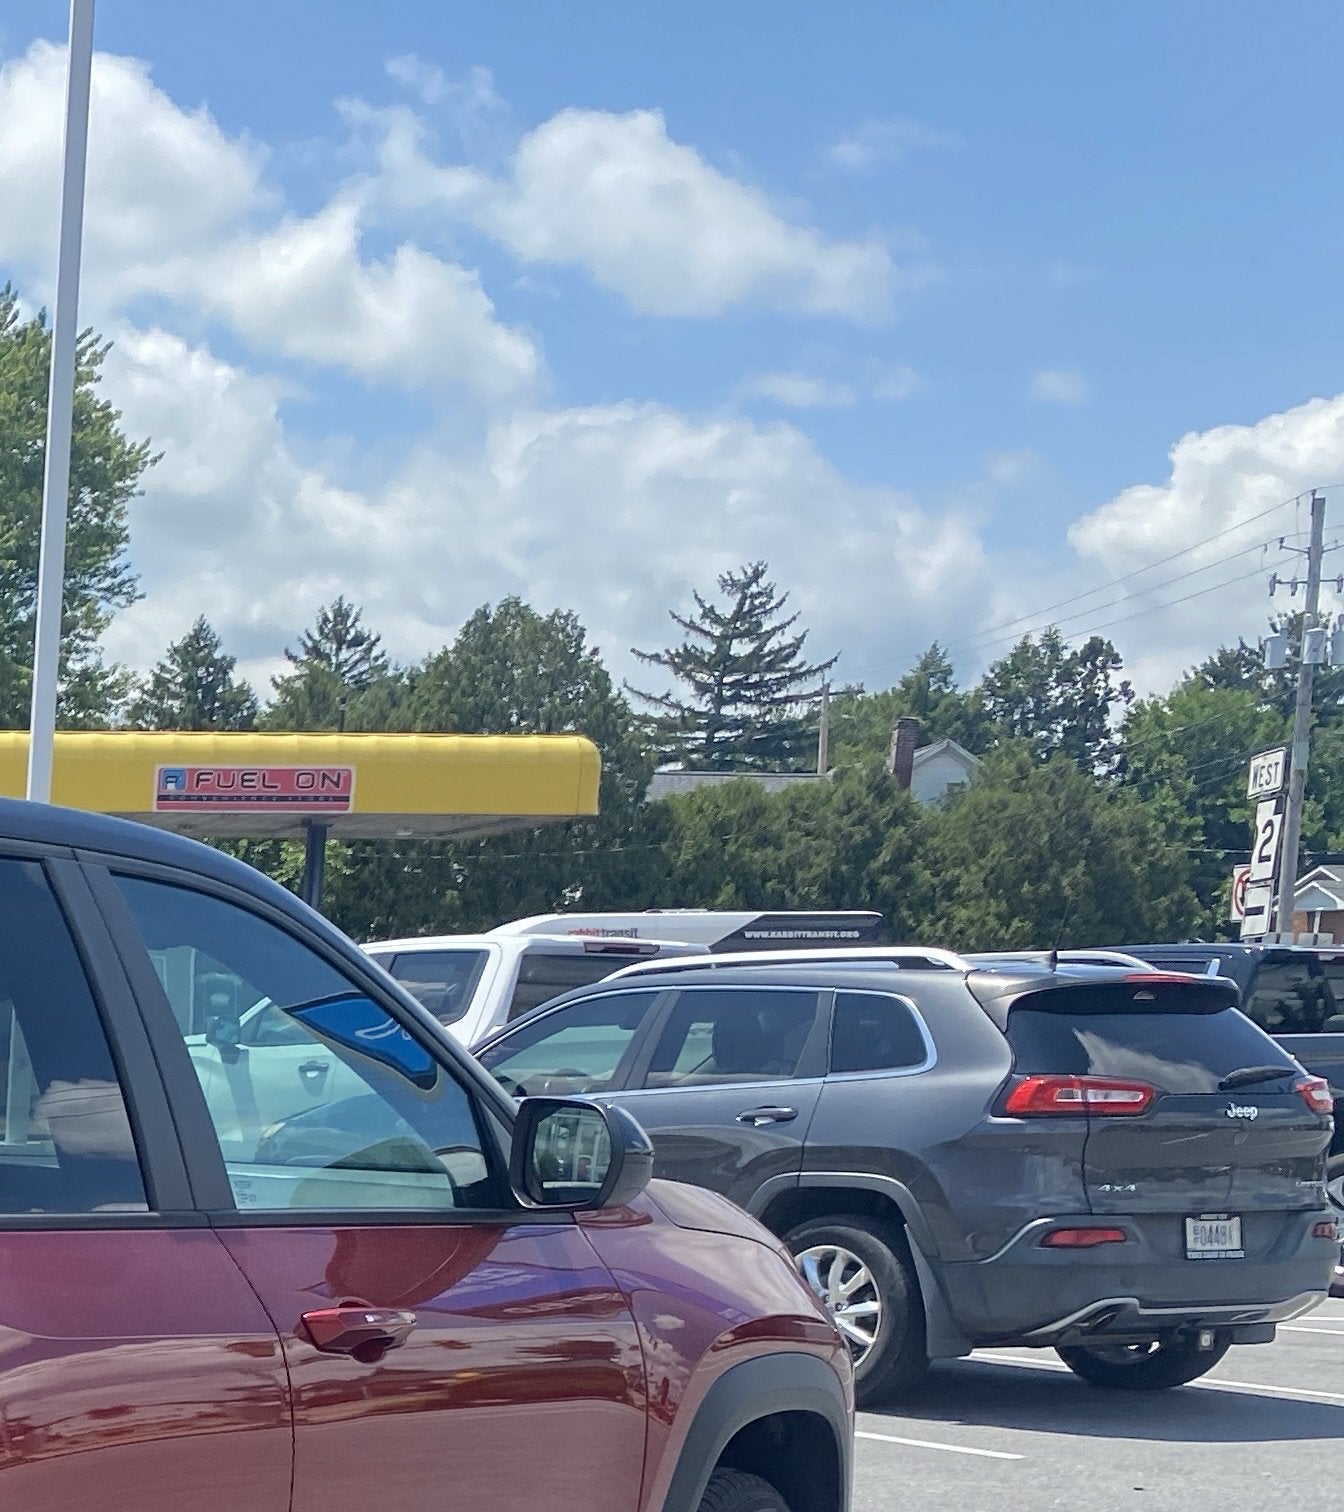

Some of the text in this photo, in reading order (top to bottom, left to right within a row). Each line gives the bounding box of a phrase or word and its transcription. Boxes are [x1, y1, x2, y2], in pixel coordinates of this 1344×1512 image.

[195, 771, 342, 789] FUEL ON
[1251, 761, 1280, 790] WEST
[1226, 1102, 1258, 1121] Jeep
